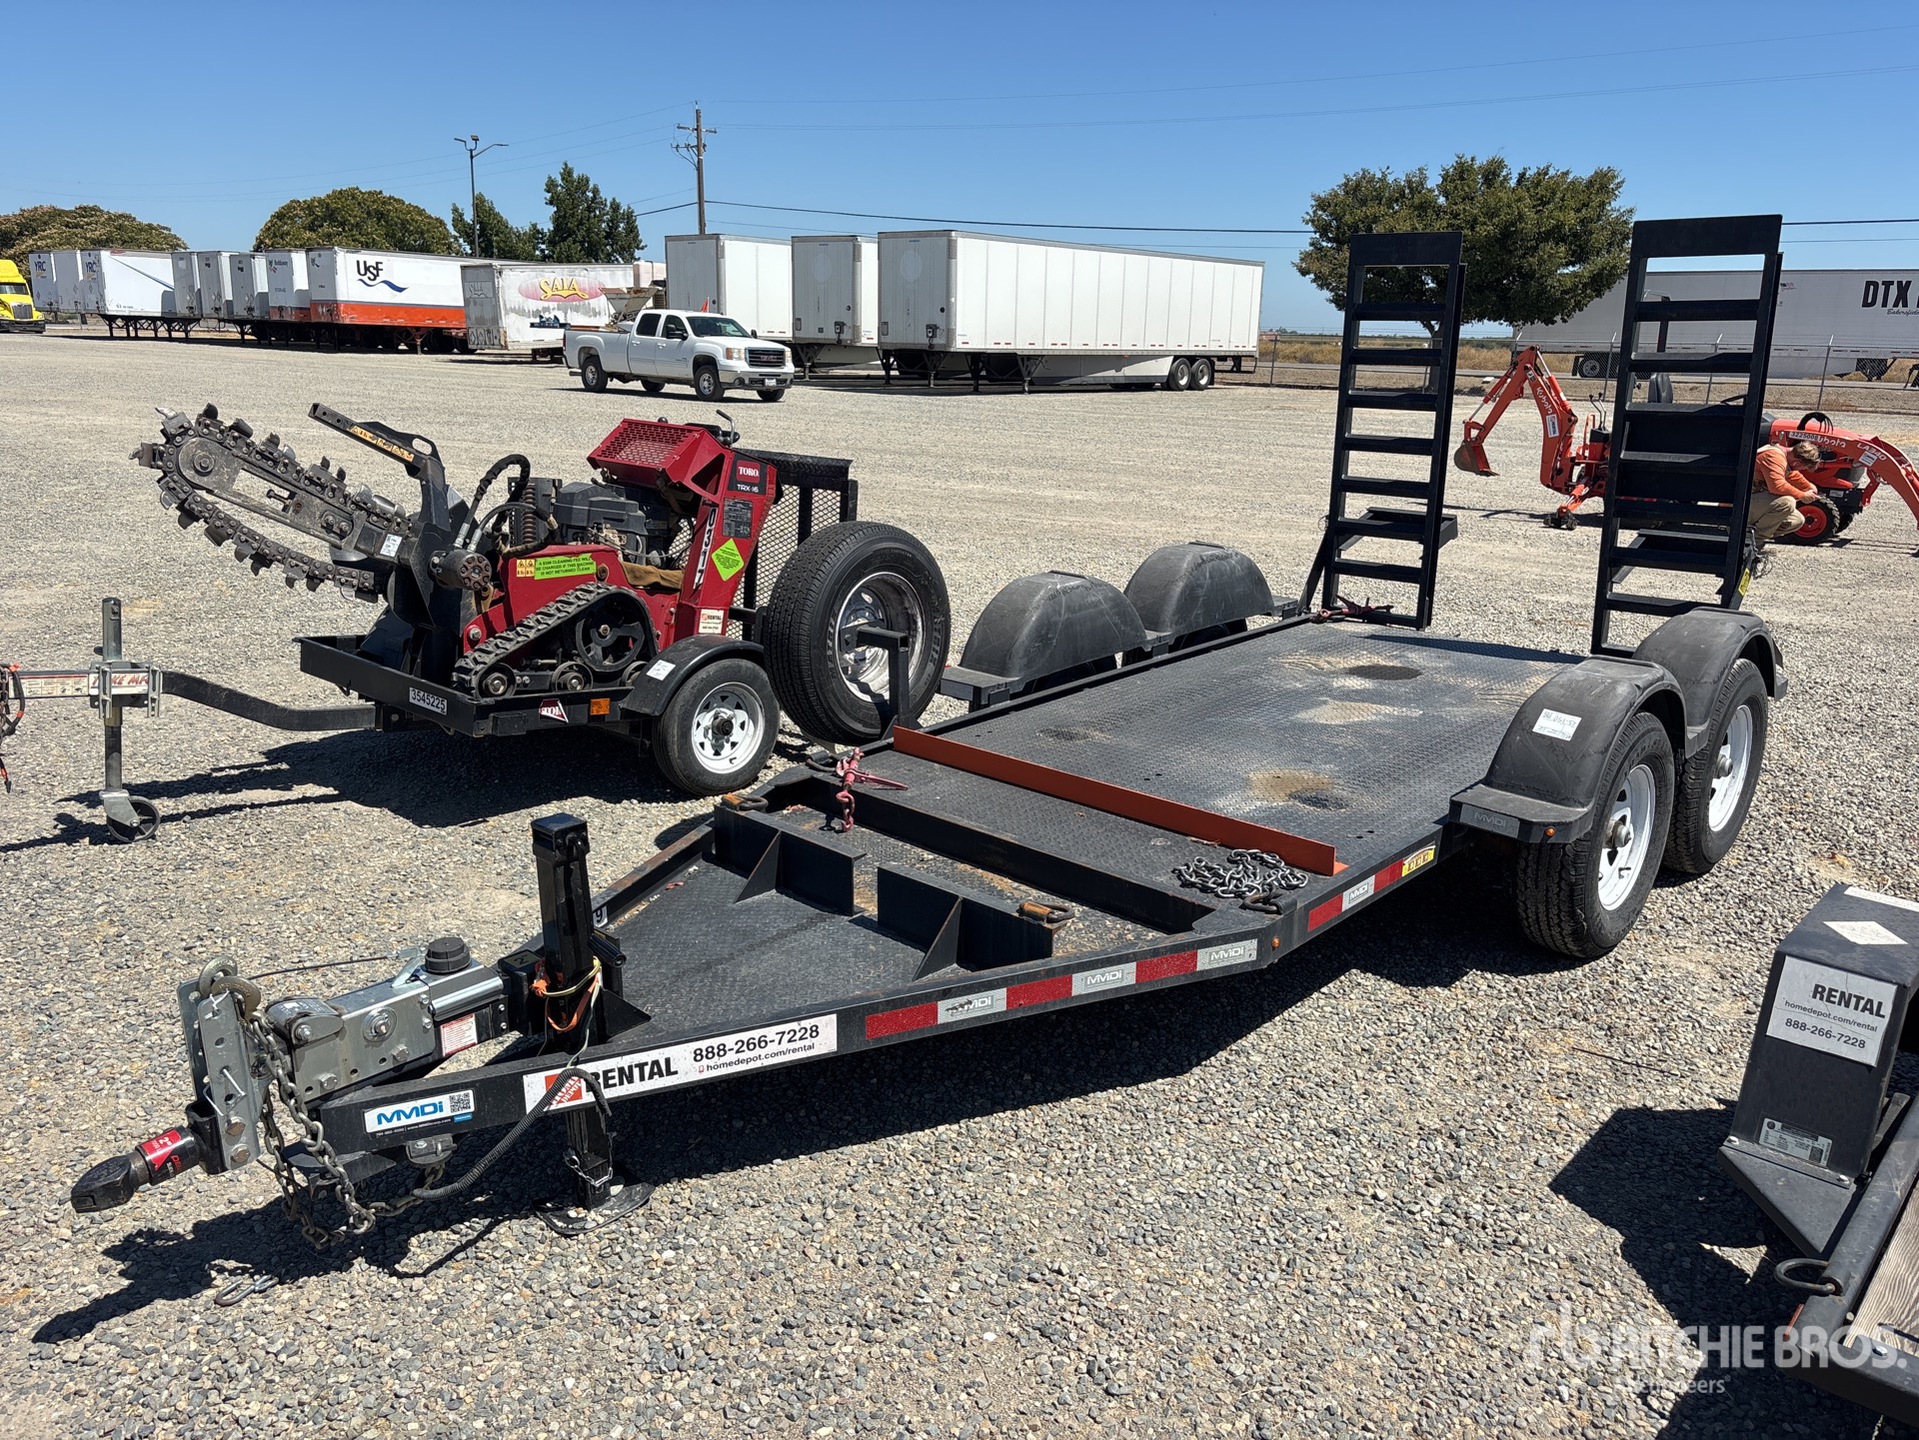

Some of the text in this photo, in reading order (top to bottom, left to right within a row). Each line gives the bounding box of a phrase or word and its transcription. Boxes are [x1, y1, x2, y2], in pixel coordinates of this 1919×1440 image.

[34, 261, 46, 272] YRC
[356, 260, 384, 281] USF
[1861, 280, 1912, 308] DTX
[1817, 435, 1846, 448] ubota
[738, 466, 760, 477] TORO
[411, 690, 446, 711] 3545225
[1811, 983, 1886, 1019] RENTAL
[1784, 1000, 1878, 1033] homedepot.com/rental
[692, 1024, 820, 1063] 888-266-7228
[1785, 1017, 1867, 1049] 888-266-7228
[706, 1042, 815, 1072] homedepot.com/rental
[376, 1101, 444, 1126] MMDi
